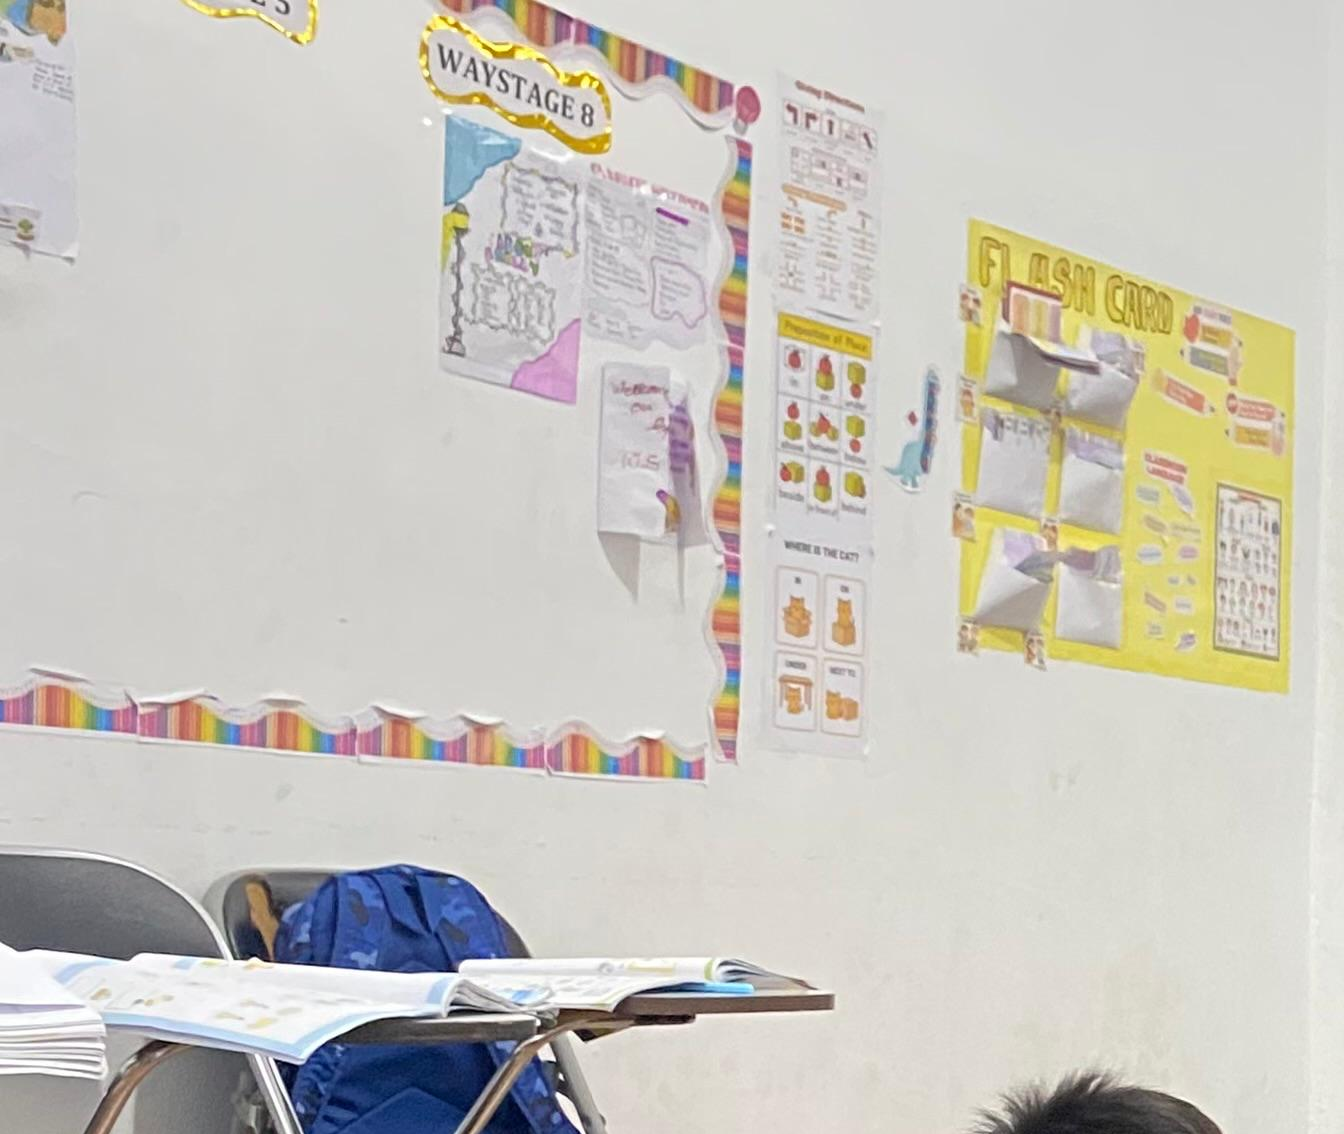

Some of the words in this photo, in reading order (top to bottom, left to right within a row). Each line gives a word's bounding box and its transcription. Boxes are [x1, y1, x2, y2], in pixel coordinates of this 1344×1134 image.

[437, 43, 575, 121] WAYSTAGE
[581, 102, 595, 128] 8
[1105, 274, 1174, 335] CARD
[784, 540, 813, 555] WHERE
[813, 547, 822, 556] IS
[823, 547, 838, 560] THE
[839, 549, 860, 563] CAT?
